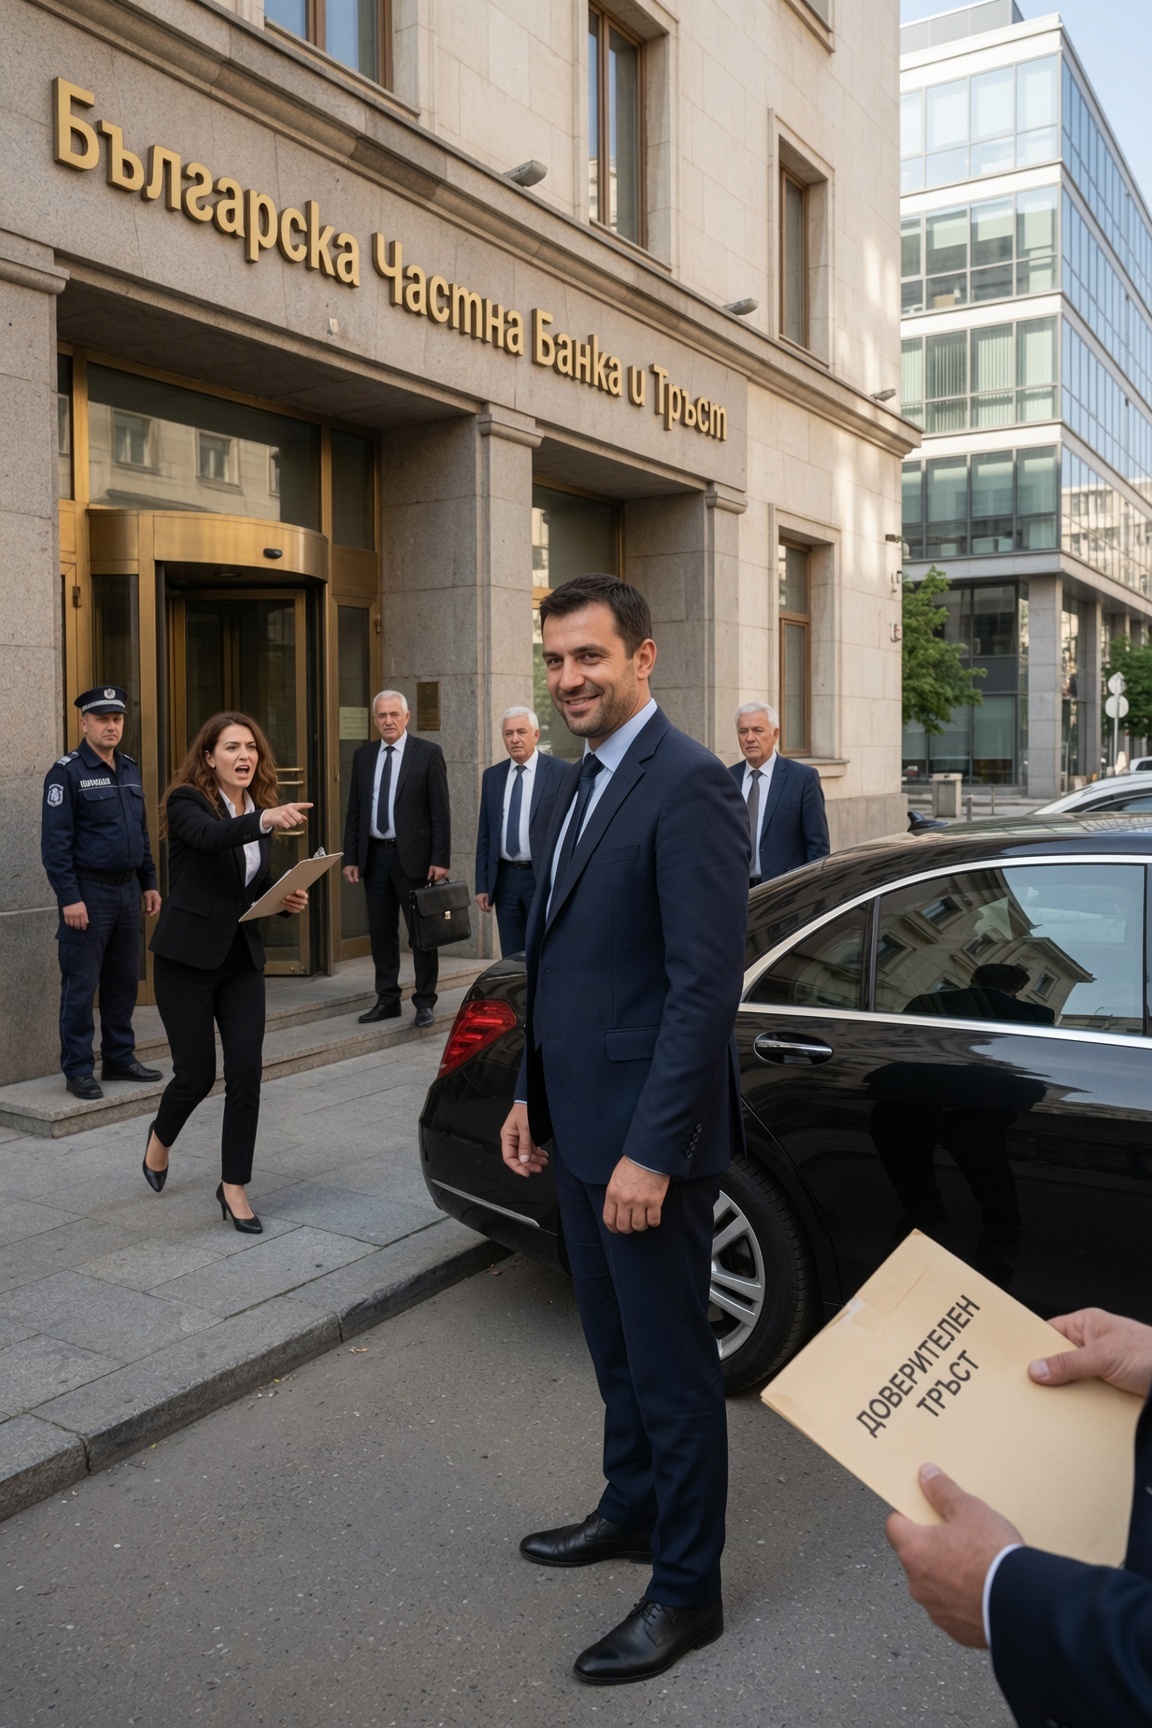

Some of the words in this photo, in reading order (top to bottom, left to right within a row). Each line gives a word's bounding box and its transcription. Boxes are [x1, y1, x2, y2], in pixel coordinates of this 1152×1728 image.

[53, 77, 360, 287] Българска
[372, 232, 524, 357] Частна
[532, 308, 623, 397] Банка
[628, 365, 646, 407] и
[649, 363, 728, 441] Тръст
[857, 1294, 980, 1438] ДОВЕРИТЕЛЕН
[917, 1350, 979, 1417] ТРЪСТ
